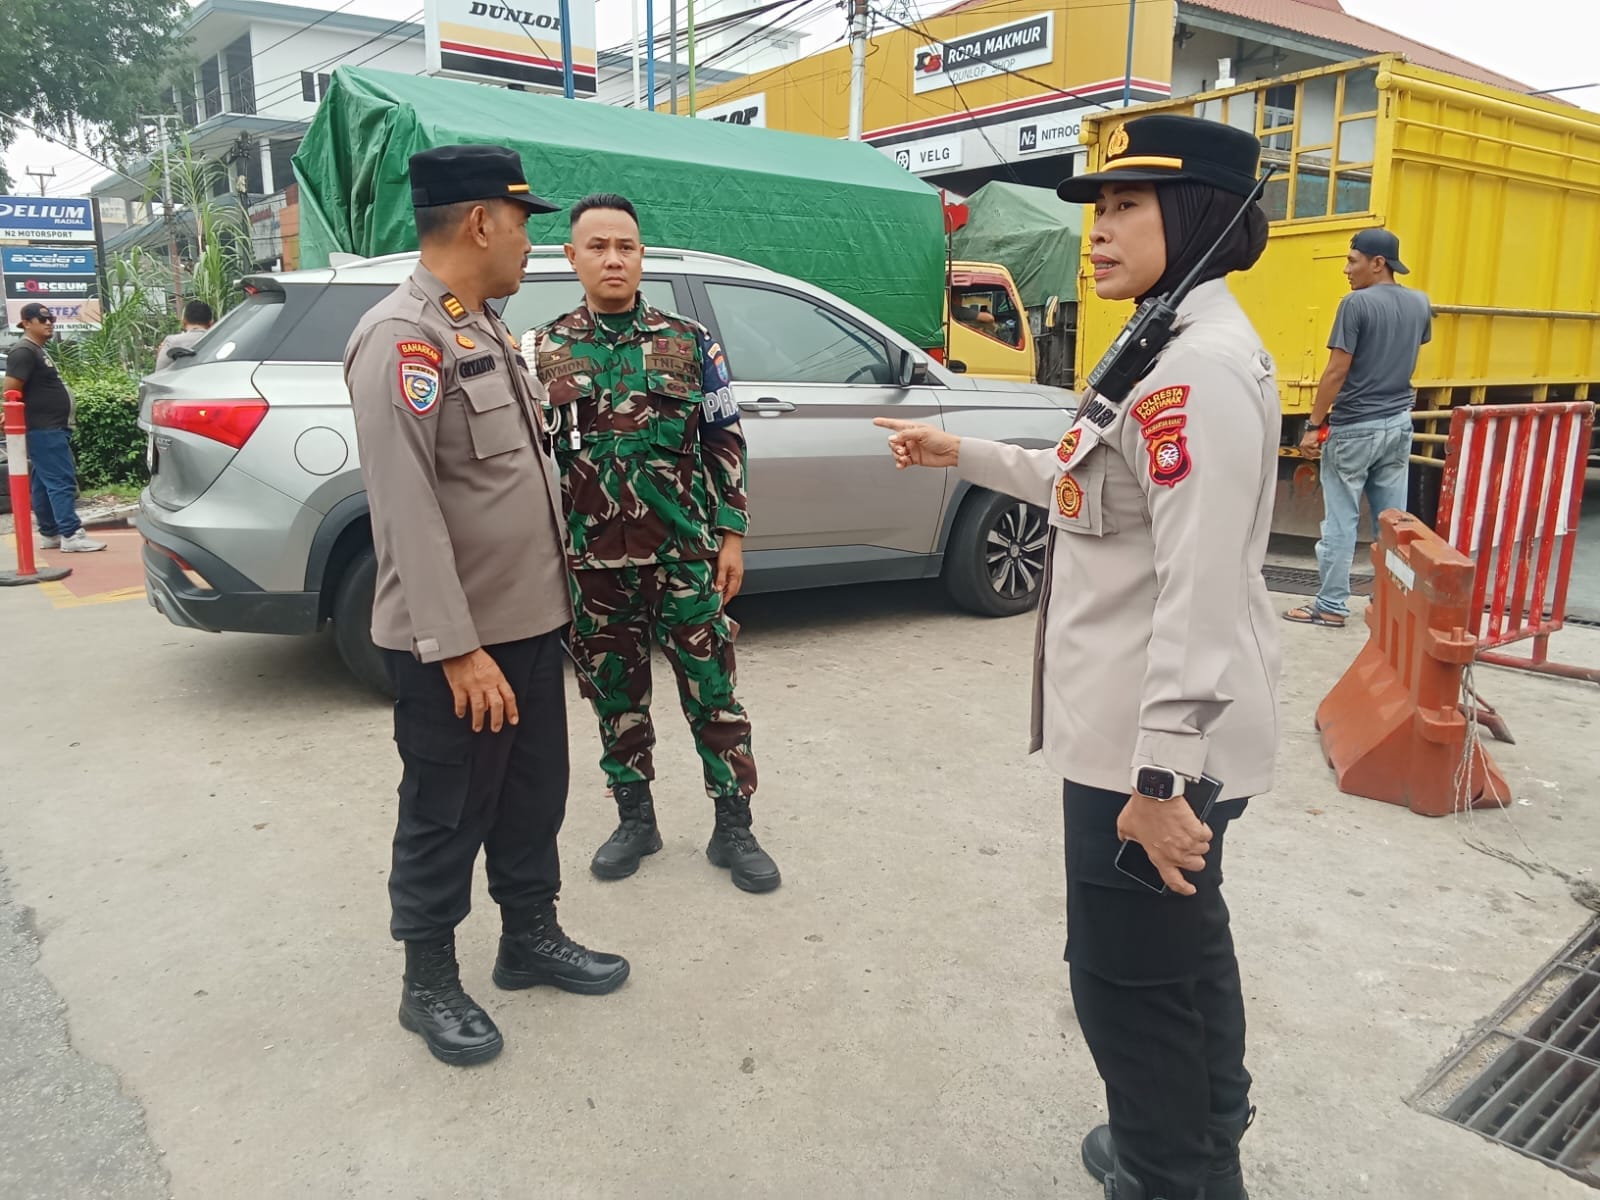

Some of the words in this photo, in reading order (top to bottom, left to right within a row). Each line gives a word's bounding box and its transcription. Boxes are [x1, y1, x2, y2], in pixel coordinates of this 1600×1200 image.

[948, 41, 982, 64] RODA
[984, 26, 1041, 55] MAKMUR
[952, 65, 986, 82] DUNLOP
[991, 58, 1016, 73] SHOP
[1041, 124, 1080, 141] NITROG
[920, 147, 950, 163] VELG
[16, 279, 88, 293] FORCEUM
[1135, 387, 1183, 415] POLRESTA
